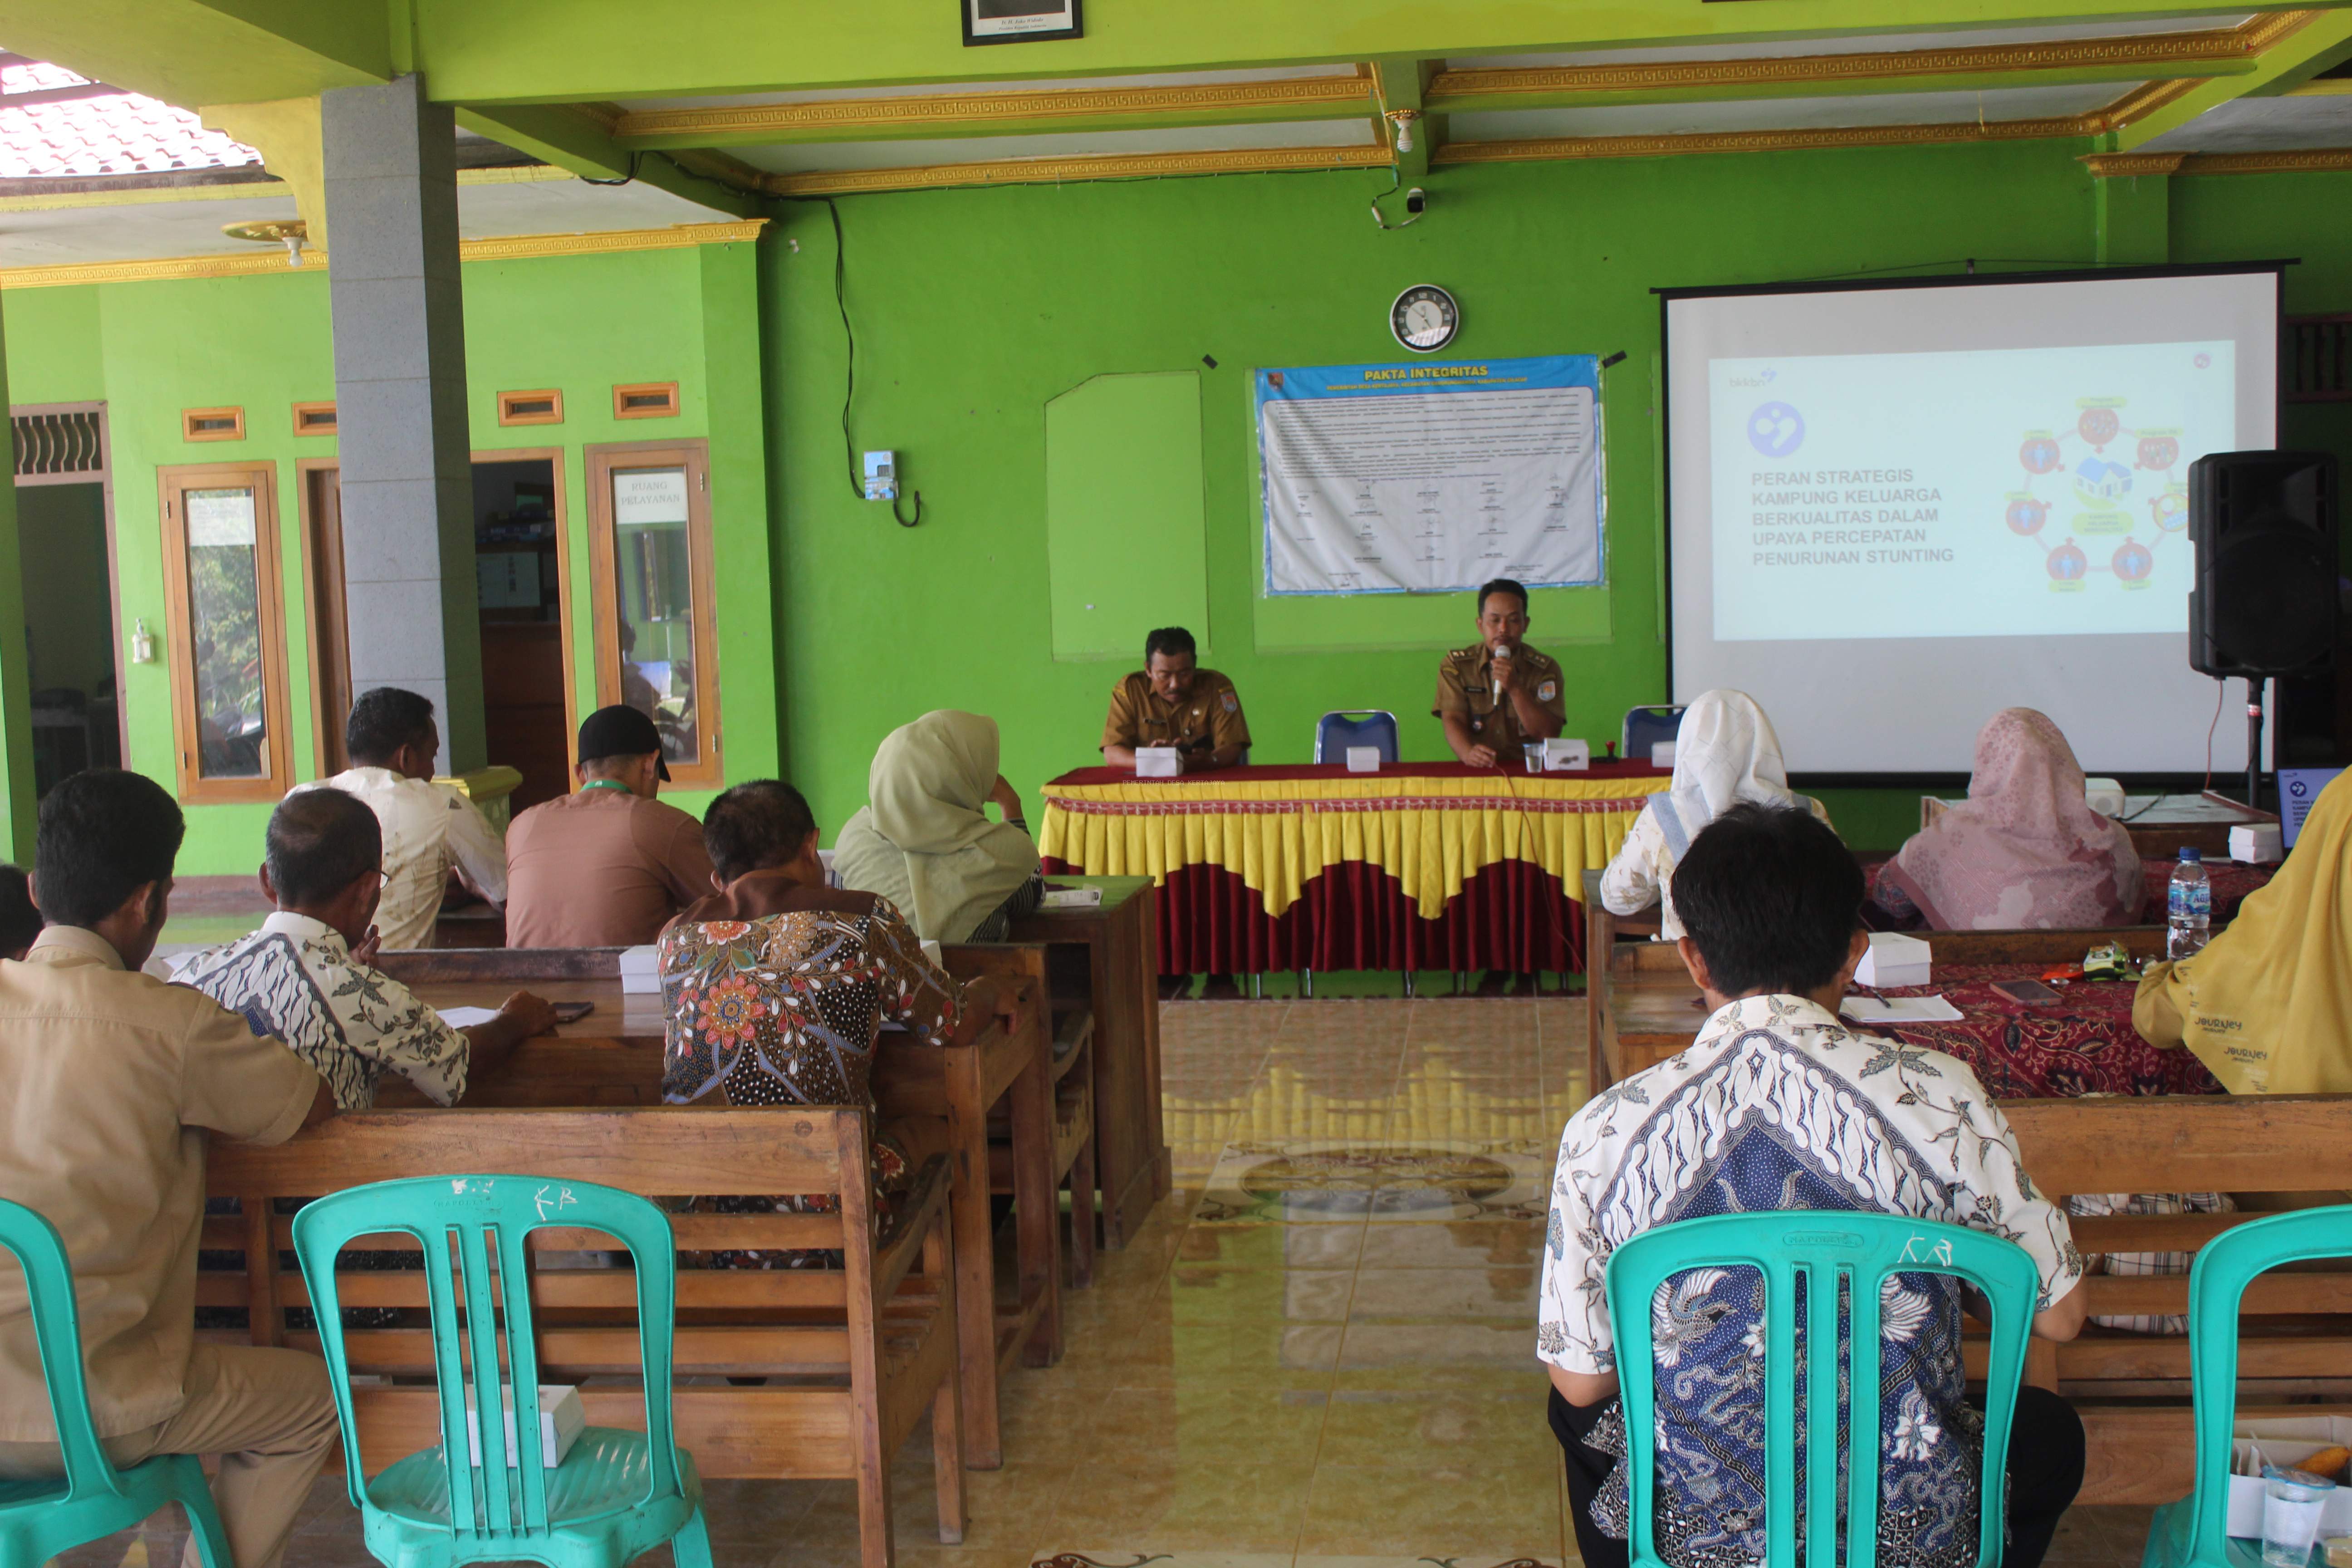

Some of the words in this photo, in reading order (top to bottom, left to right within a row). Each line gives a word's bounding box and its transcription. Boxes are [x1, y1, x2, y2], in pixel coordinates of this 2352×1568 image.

[1364, 369, 1406, 381] PAKTA
[1410, 366, 1489, 379] INTEGRITAS
[632, 481, 668, 491] RUANG
[1751, 470, 1811, 486] PERAN
[1816, 468, 1914, 485] STRATEGIS
[621, 494, 680, 505] PELAYANAN
[1751, 490, 1838, 506] KAMPUNG
[1845, 488, 1942, 504] KELUARGA
[1752, 510, 1872, 526] BERKUALITAS
[1877, 508, 1939, 524] DALAM
[1753, 531, 1807, 546] UPAYA
[1811, 528, 1926, 544] PERCEPATAN
[1753, 550, 1860, 566] PENURUNAN
[1866, 548, 1955, 564] STUNTING
